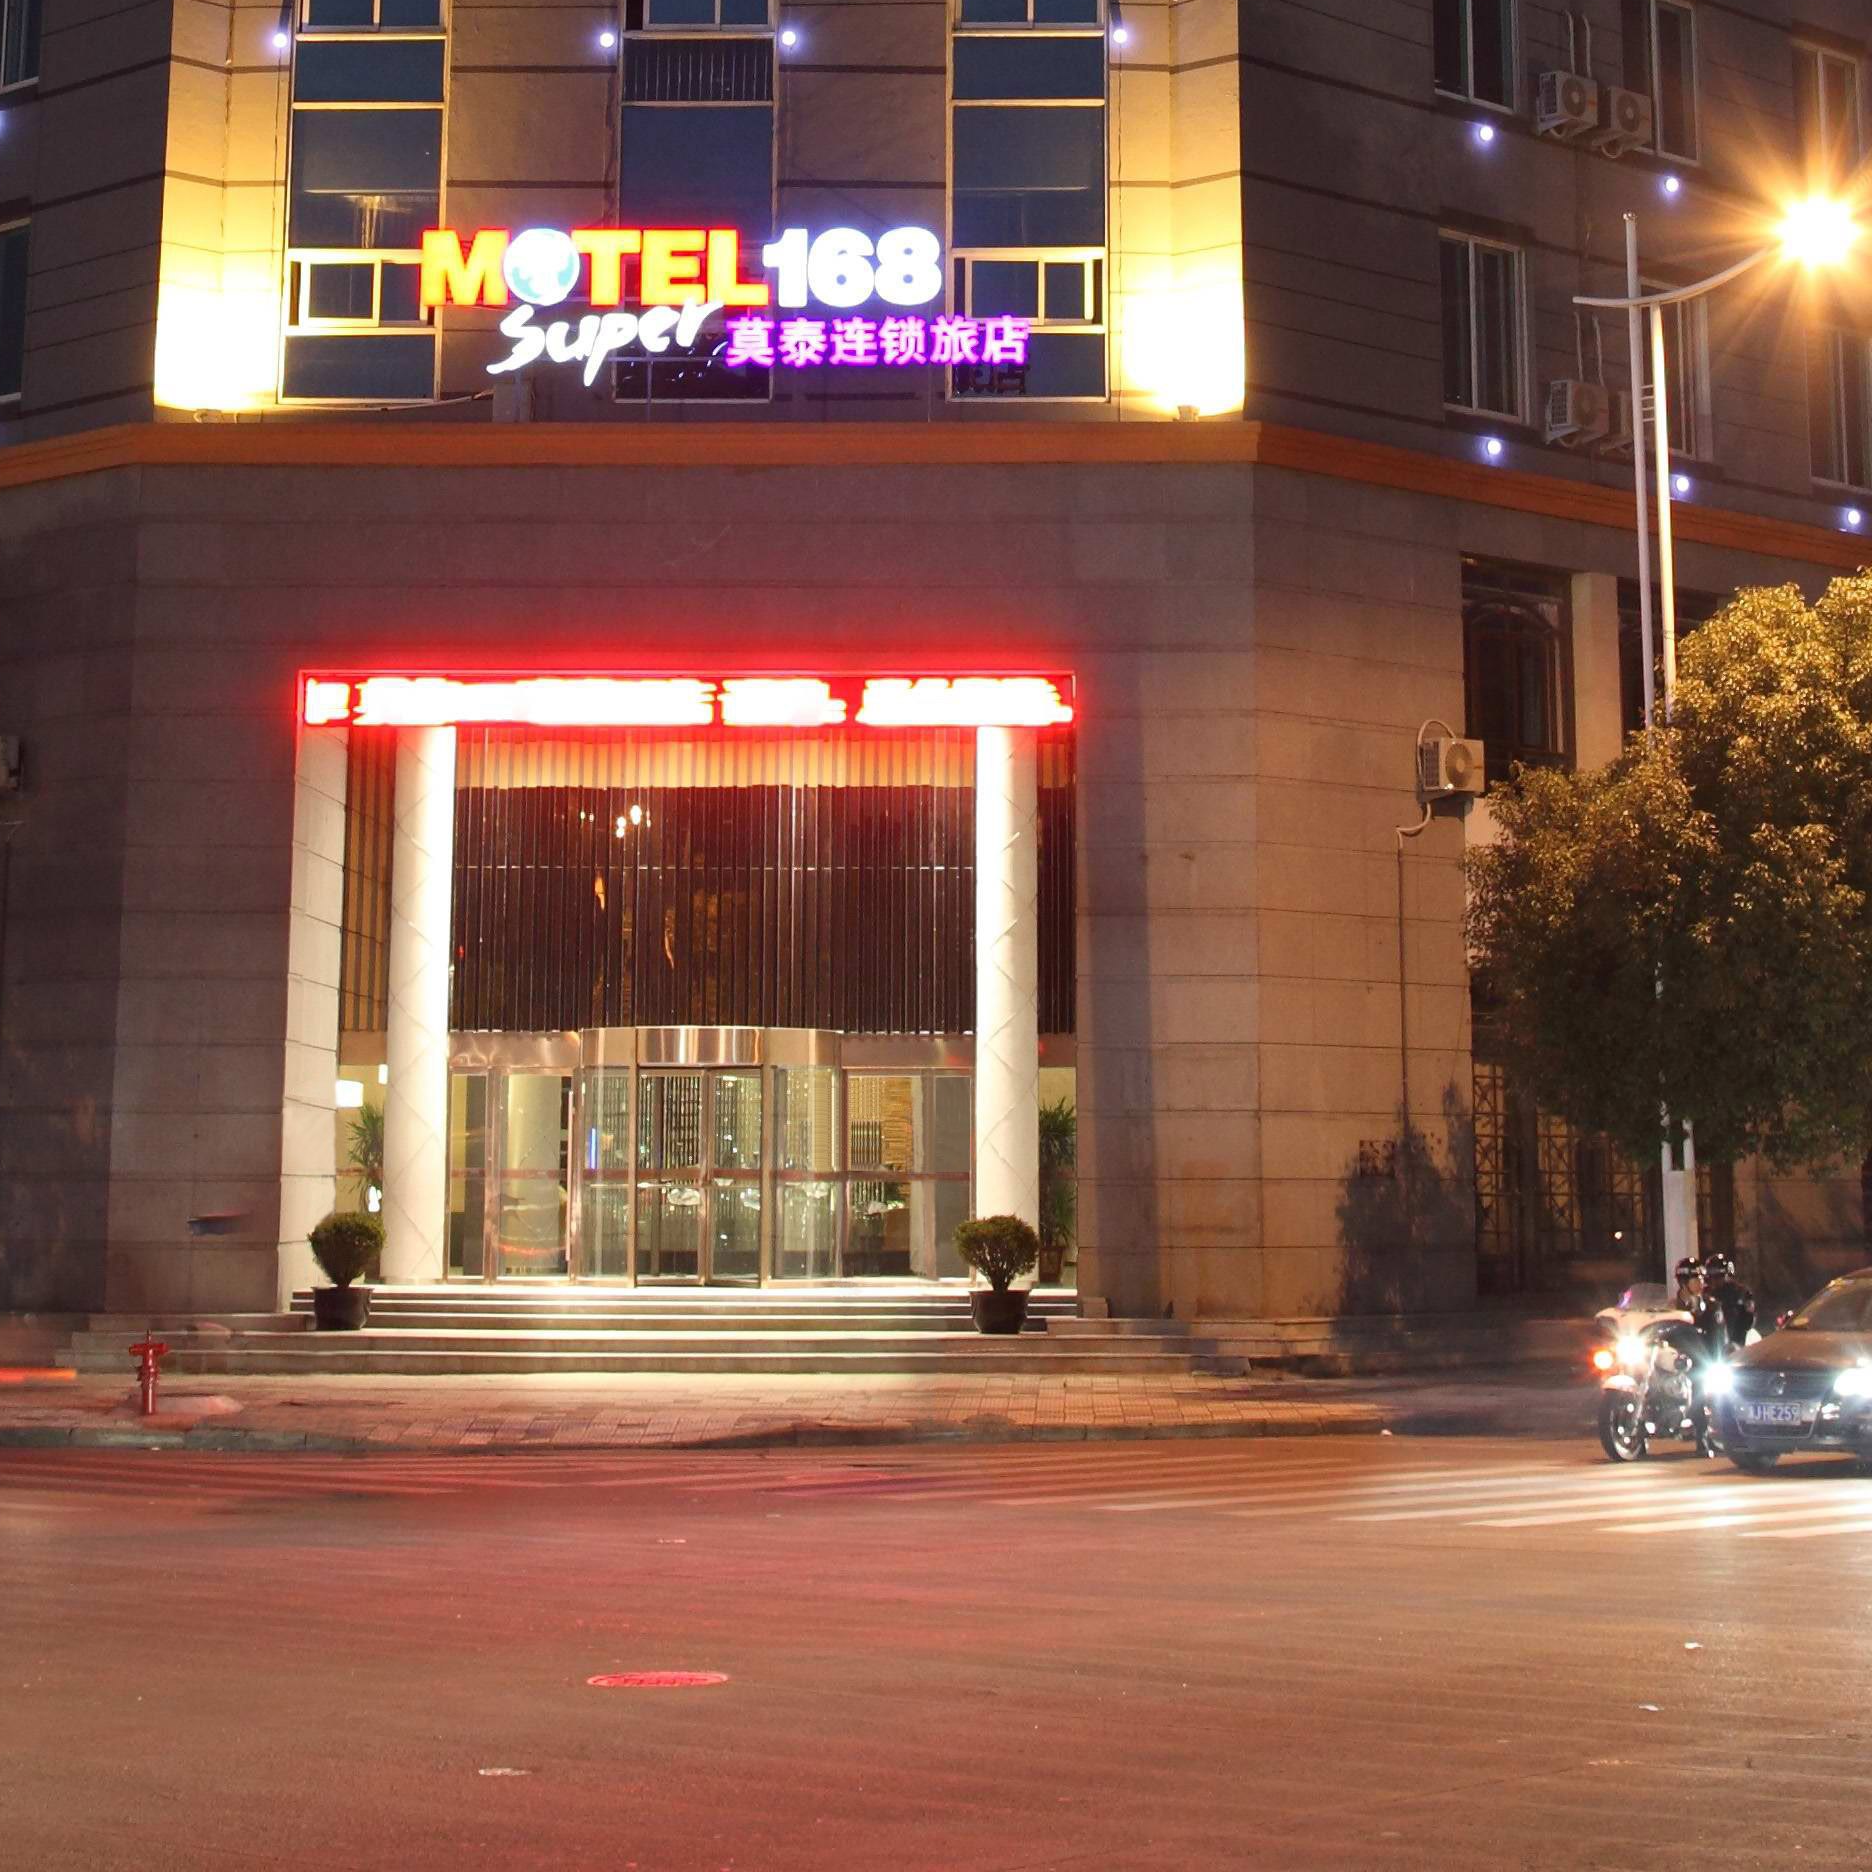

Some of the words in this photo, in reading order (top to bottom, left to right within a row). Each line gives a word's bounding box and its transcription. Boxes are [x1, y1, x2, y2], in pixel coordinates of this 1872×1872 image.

[485, 296, 726, 388] Super
[725, 314, 1030, 367] 莫泰连锁旅店
